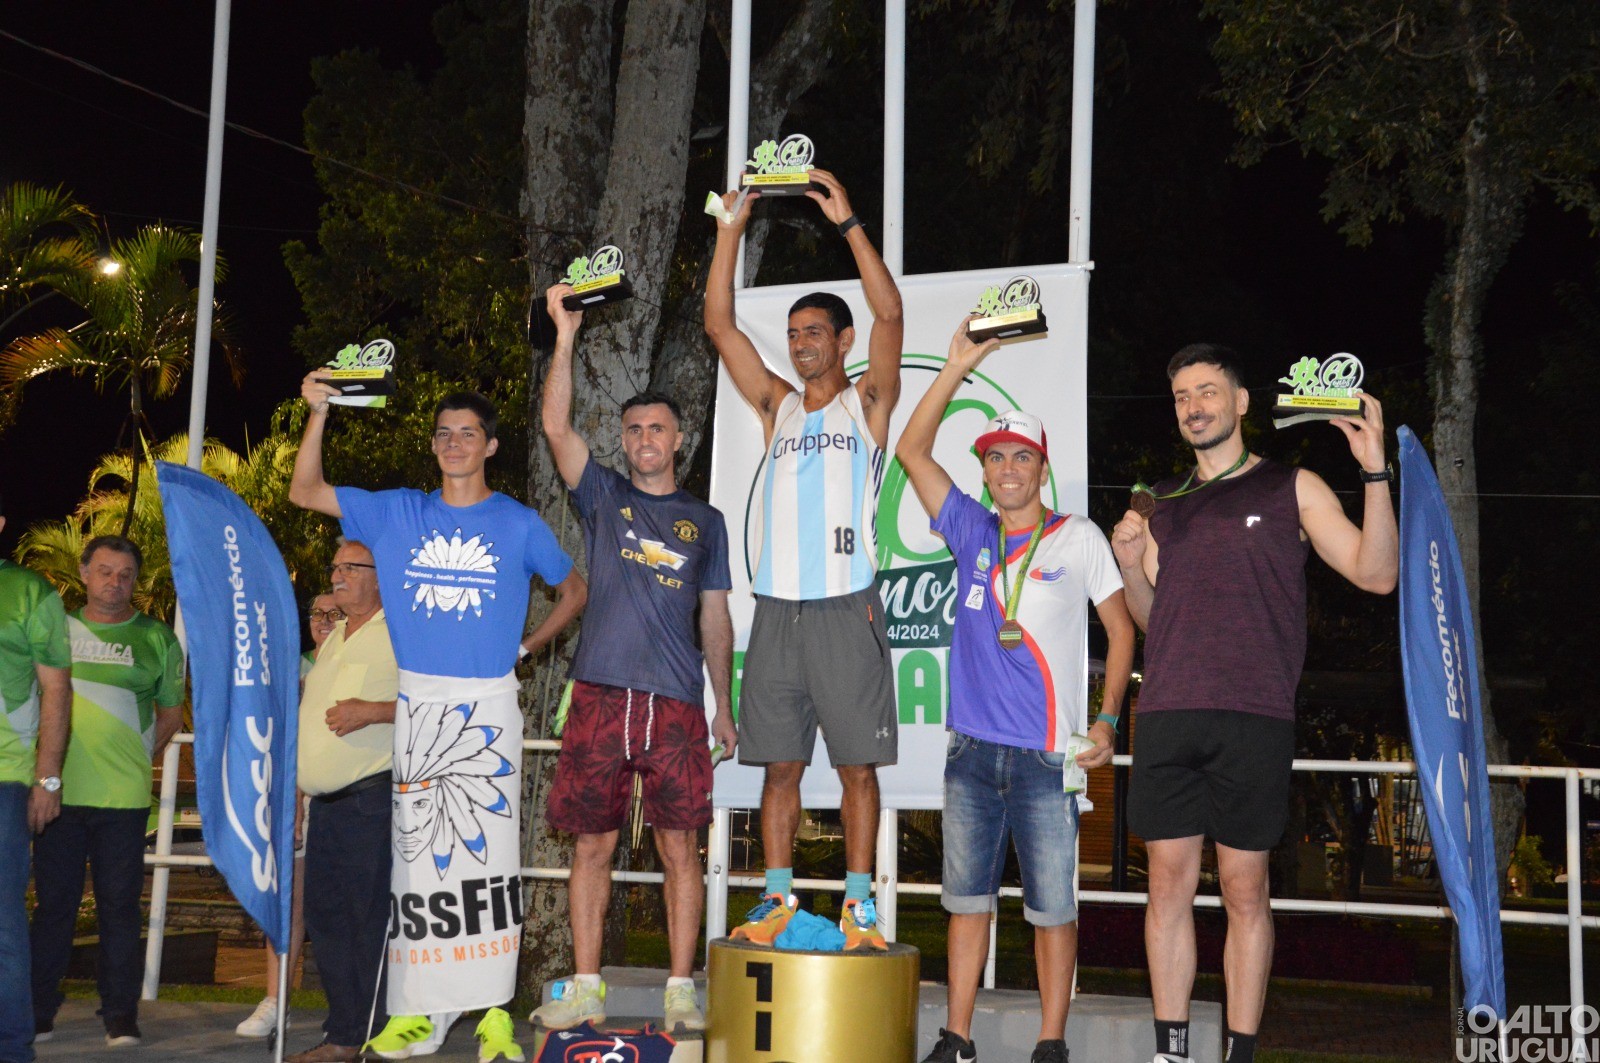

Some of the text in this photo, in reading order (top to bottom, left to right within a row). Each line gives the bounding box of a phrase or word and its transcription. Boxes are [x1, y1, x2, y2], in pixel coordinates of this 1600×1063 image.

[773, 433, 858, 460] Gruppen
[834, 526, 855, 556] 18
[224, 525, 255, 687] Fecomércio
[886, 624, 941, 641] 4/2024
[1429, 540, 1461, 720] Fecomércio
[71, 637, 134, 660] ÚSTICA
[410, 947, 443, 965] DAS
[453, 934, 519, 962] MISSÕE
